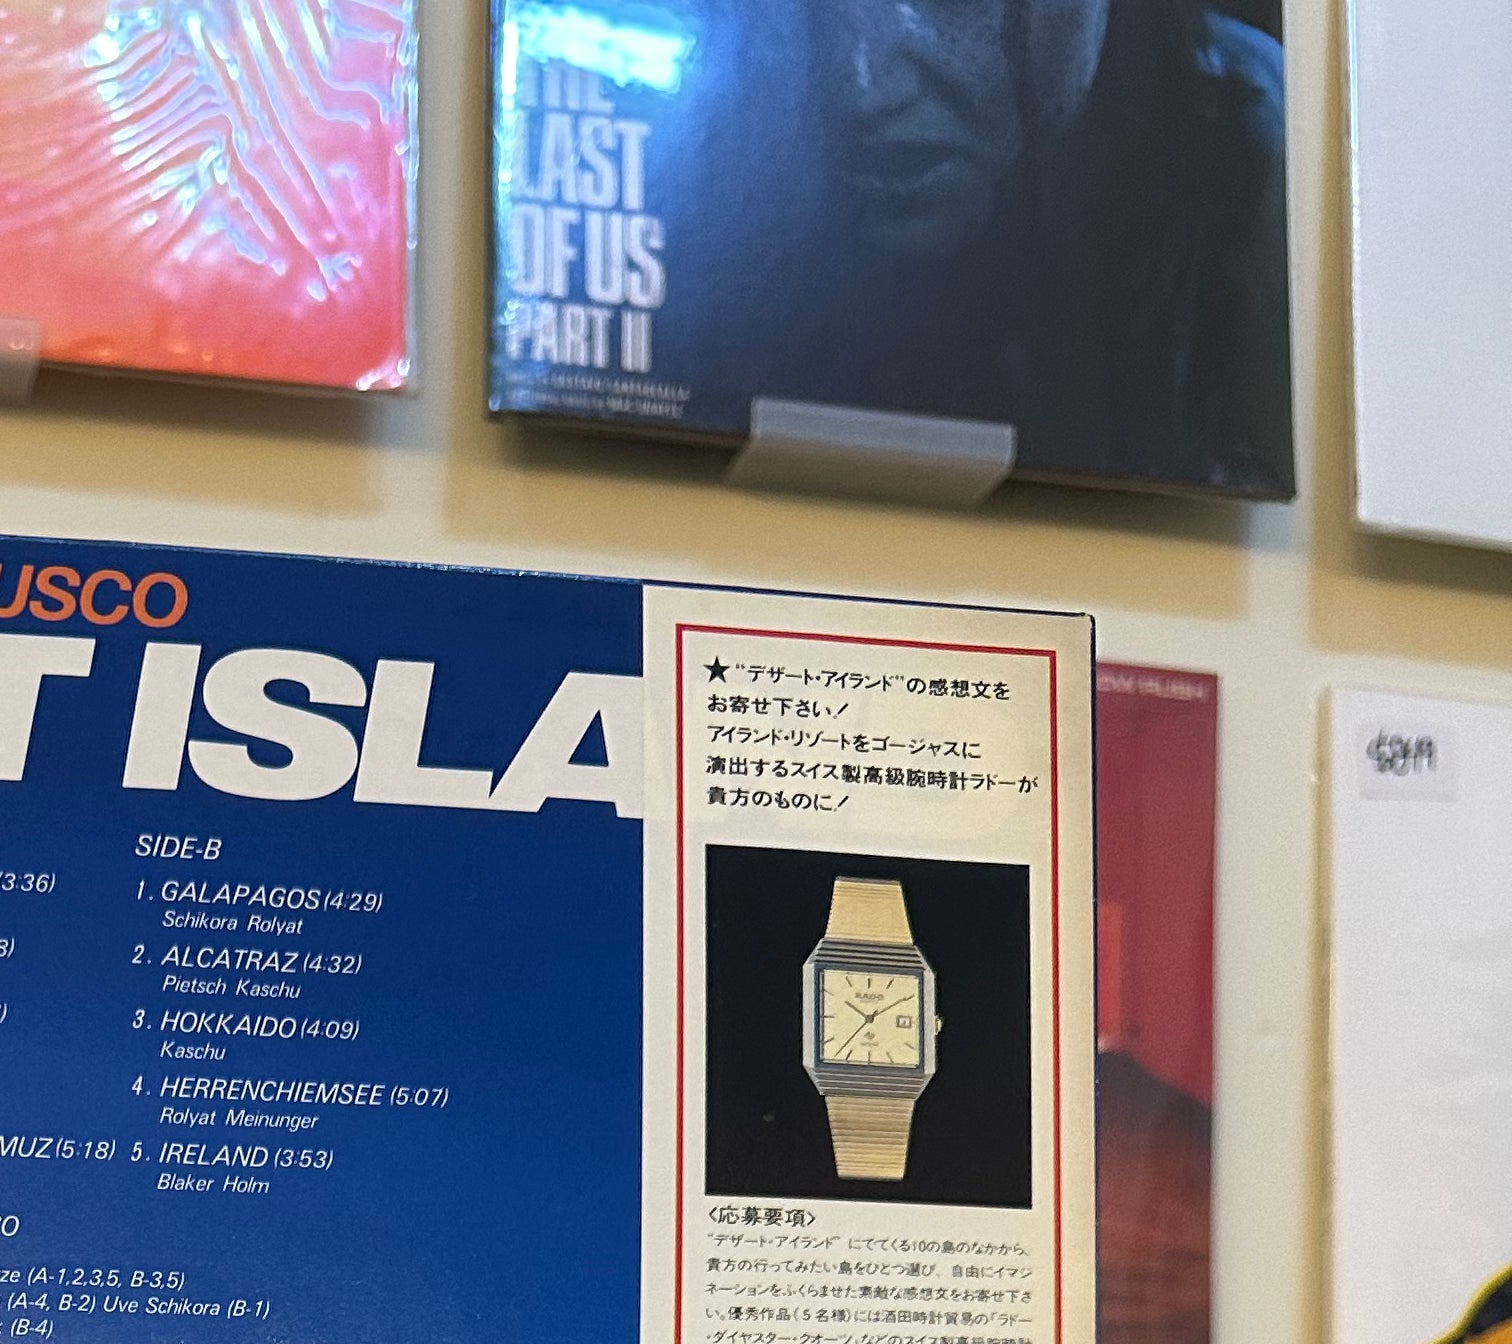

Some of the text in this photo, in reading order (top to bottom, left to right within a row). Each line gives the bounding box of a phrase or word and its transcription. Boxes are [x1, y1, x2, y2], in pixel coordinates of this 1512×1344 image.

[510, 109, 649, 210] LAST
[510, 204, 666, 309] OF US
[505, 300, 652, 373] PART II
[135, 834, 222, 860] SIDE-B
[136, 881, 383, 913] 1. GALAPAGOS (4:29)
[162, 910, 303, 936] Schikora Rolyat
[131, 945, 361, 975] 2. ALCATRAZ (4:32)
[162, 976, 301, 999] Pietsch Kaschu
[132, 1009, 359, 1041] 3. HOKKAIDO (4:09)
[160, 1042, 225, 1061] Kaschu
[132, 1075, 449, 1108] 4. HERRENCHIEMSEE (5:07)
[160, 1108, 319, 1132] Rolyat Meinunger
[56, 1138, 116, 1161] (5:18)
[131, 1142, 333, 1170] 5. IRELAND (3:53)
[157, 1174, 269, 1194] Blaker Holm
[58, 1293, 97, 1315] B-2)
[103, 1294, 139, 1314] Uve
[145, 1296, 220, 1317] Schikora
[227, 1299, 271, 1320] (B-1)
[11, 1318, 54, 1340] (B-4)
